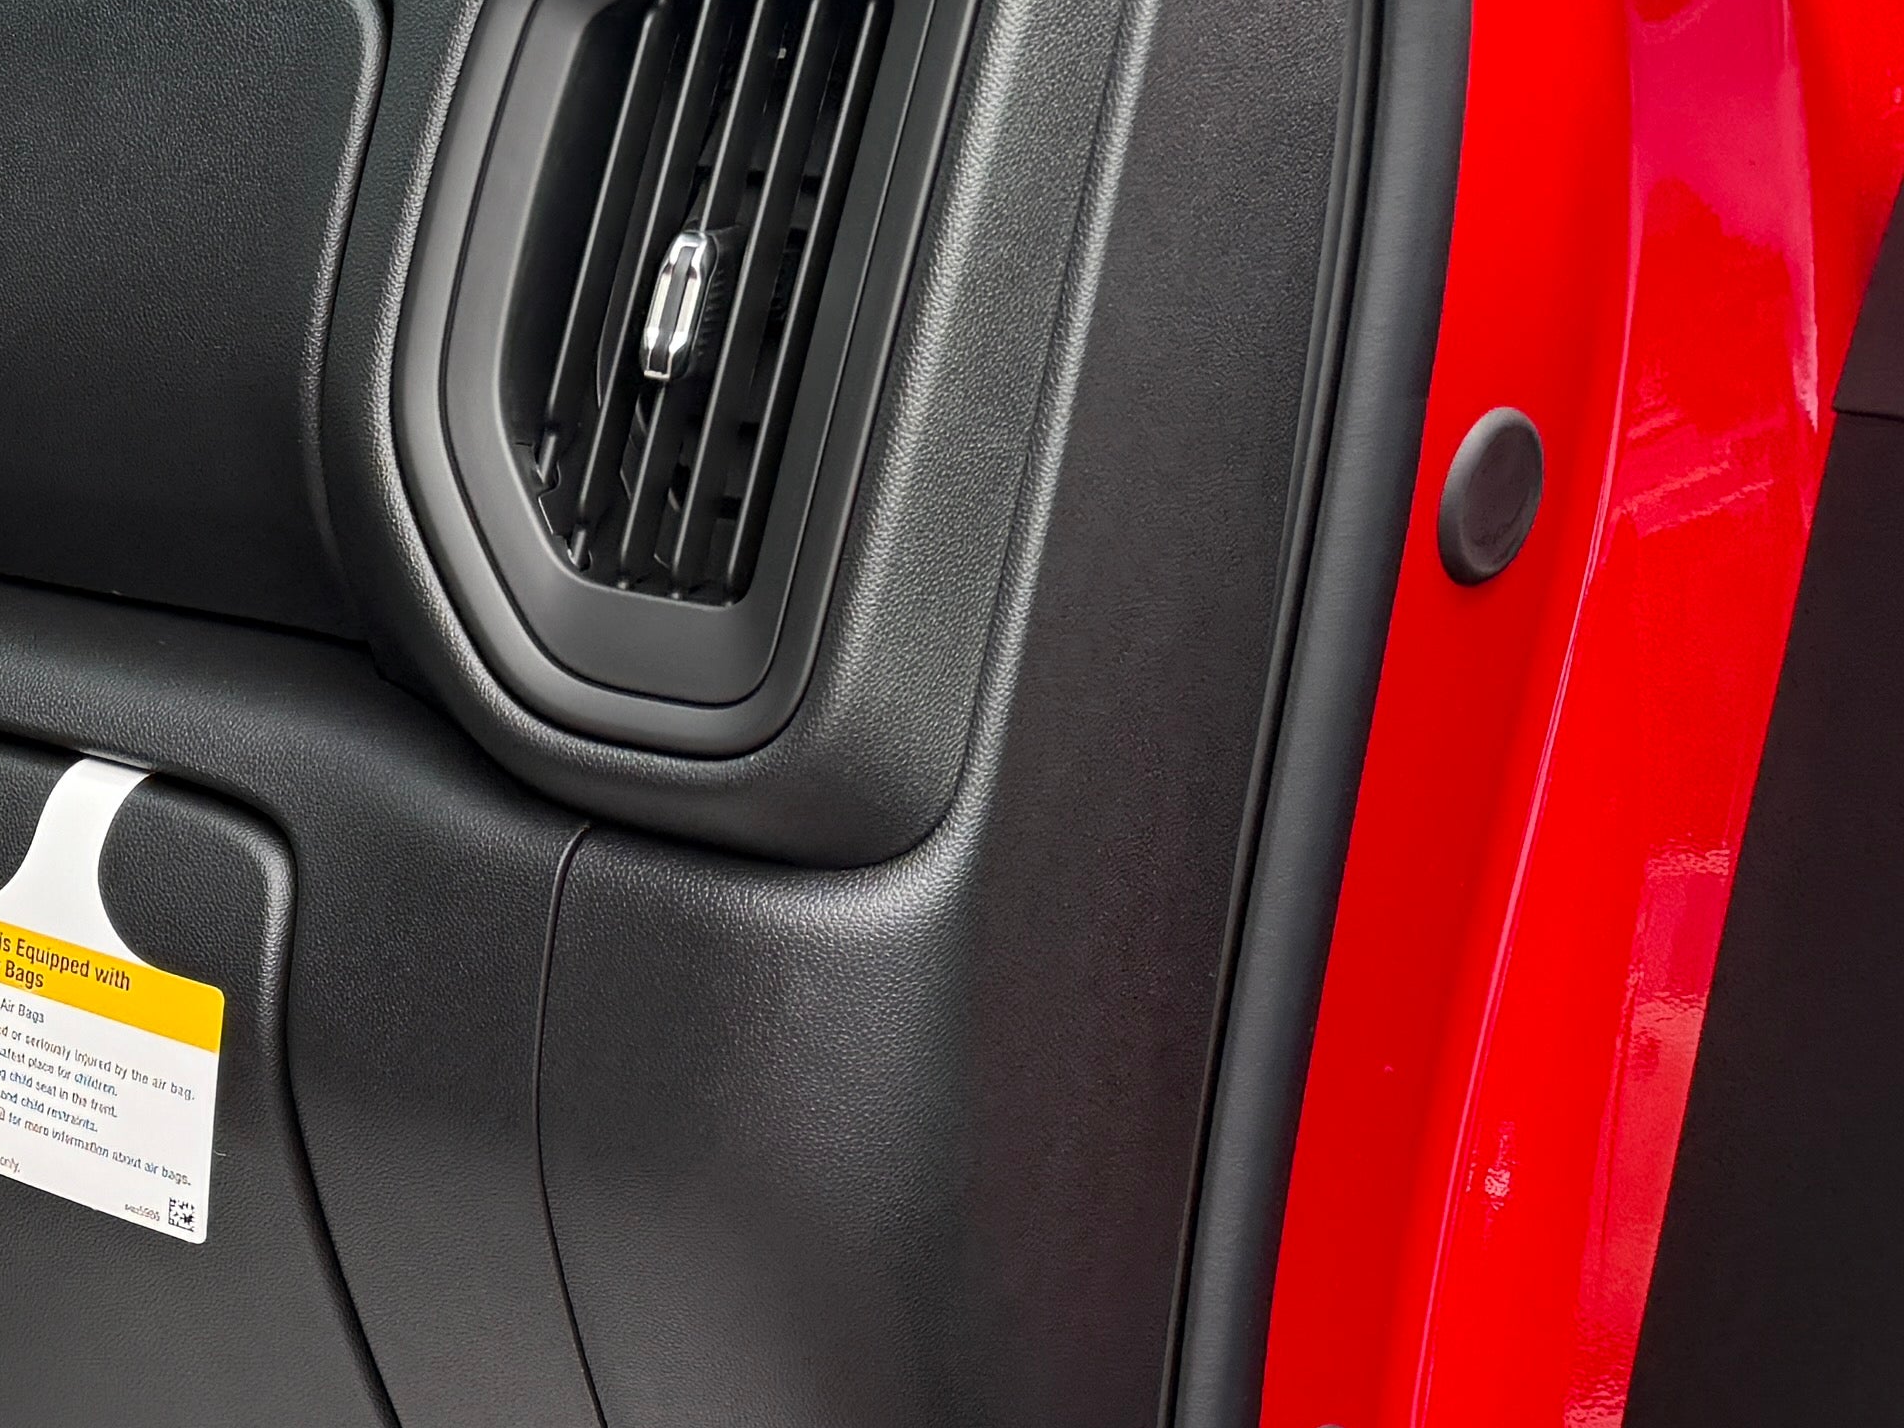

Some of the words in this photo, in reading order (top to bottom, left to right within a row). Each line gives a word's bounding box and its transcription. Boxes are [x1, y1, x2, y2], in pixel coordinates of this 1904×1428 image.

[5, 960, 44, 990] Bags
[16, 938, 90, 978] Equipped
[95, 967, 131, 991] with
[0, 998, 15, 1013] Air
[18, 1004, 44, 1024] Bags
[11, 1029, 22, 1041] or
[25, 1035, 71, 1061] seriously
[75, 1049, 111, 1072] injured
[114, 1063, 128, 1080] by
[132, 1069, 148, 1084] the
[152, 1077, 167, 1090] air
[170, 1082, 195, 1101] bag.
[28, 1057, 54, 1074] place
[58, 1065, 71, 1080] for
[9, 1072, 33, 1088] child
[35, 1081, 56, 1097] seat
[59, 1087, 69, 1101] in
[72, 1092, 88, 1108] the
[21, 1097, 45, 1114] child
[24, 1120, 49, 1136] more
[52, 1127, 109, 1158] information
[112, 1151, 141, 1169] about
[144, 1162, 159, 1174] air
[162, 1166, 192, 1186] bags.
